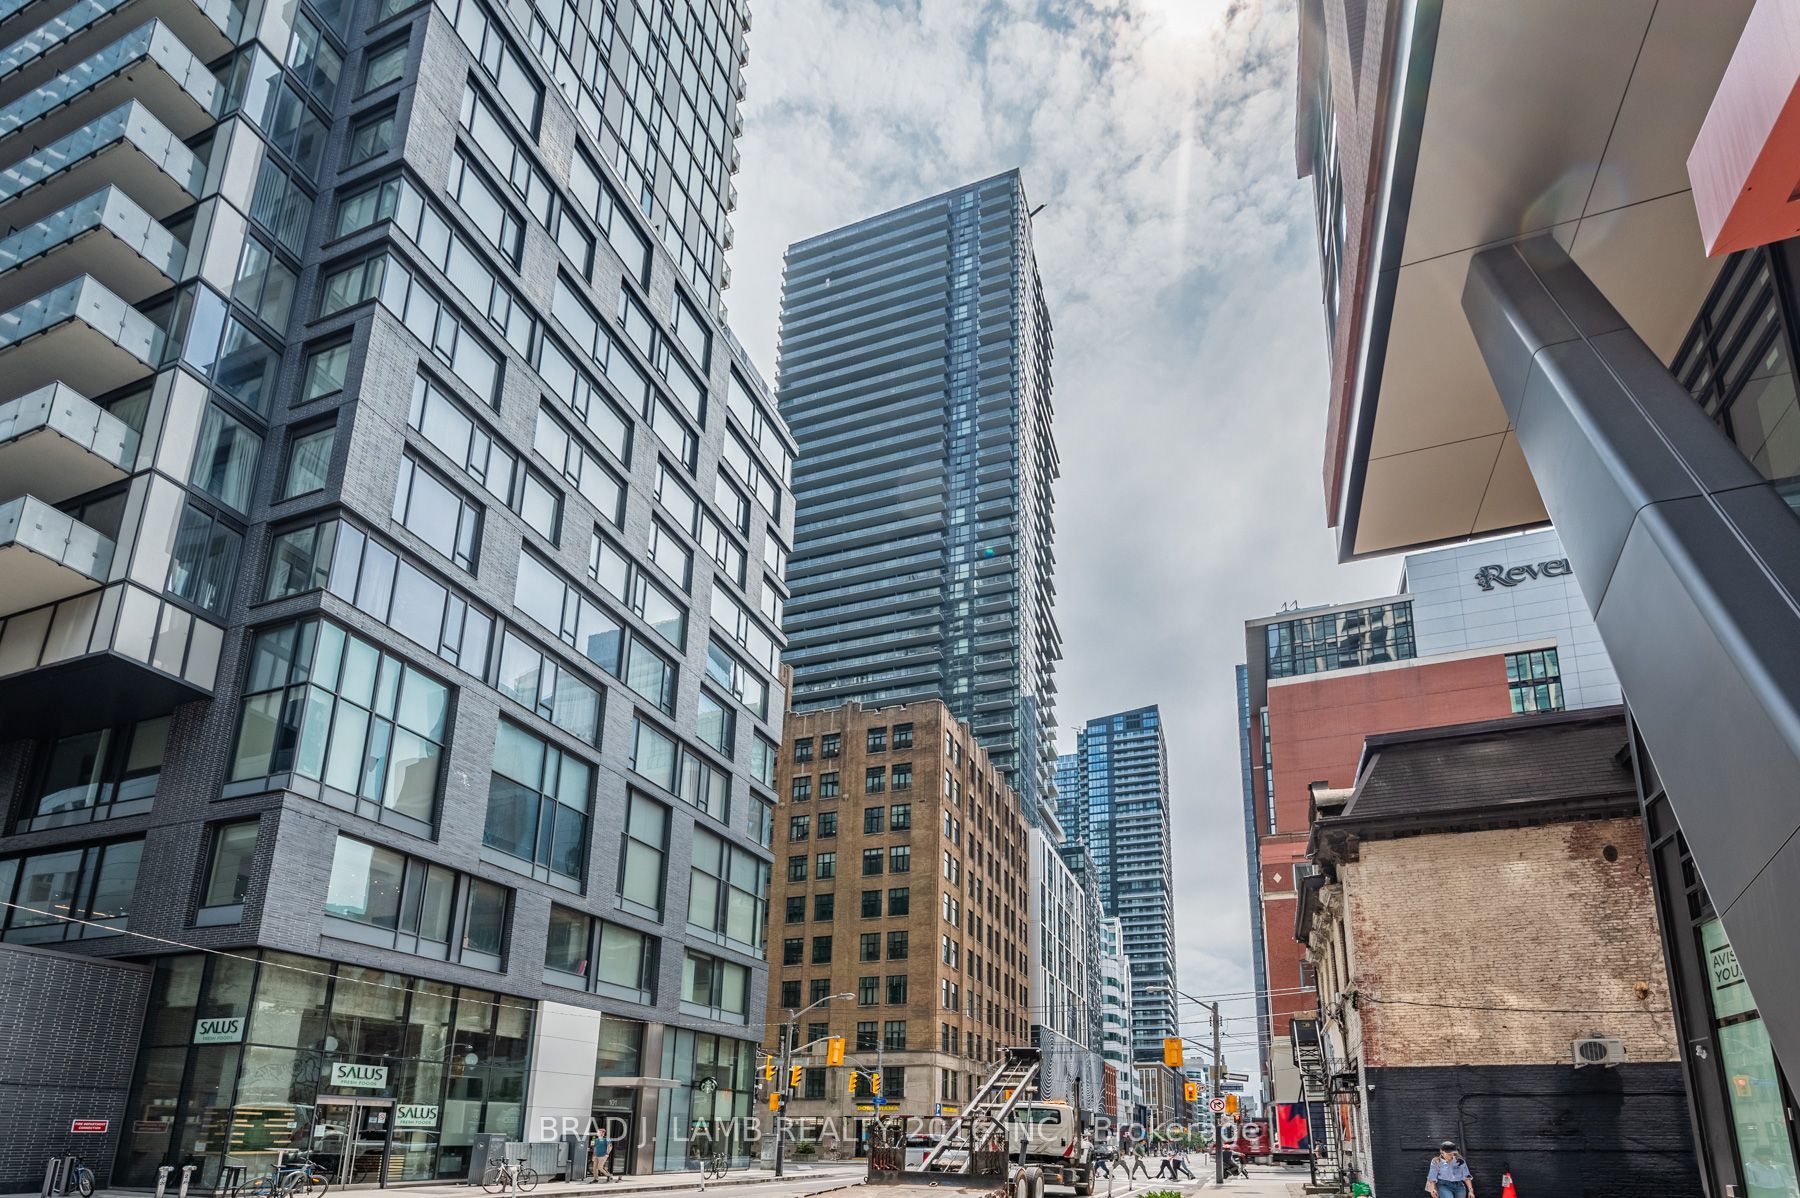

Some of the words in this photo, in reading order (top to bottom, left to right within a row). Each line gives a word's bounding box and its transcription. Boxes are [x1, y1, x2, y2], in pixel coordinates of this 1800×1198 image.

[1715, 964, 1743, 982] YOU
[199, 1020, 239, 1035] SALUS
[337, 1065, 383, 1081] SALUS
[397, 1106, 437, 1120] SALUS
